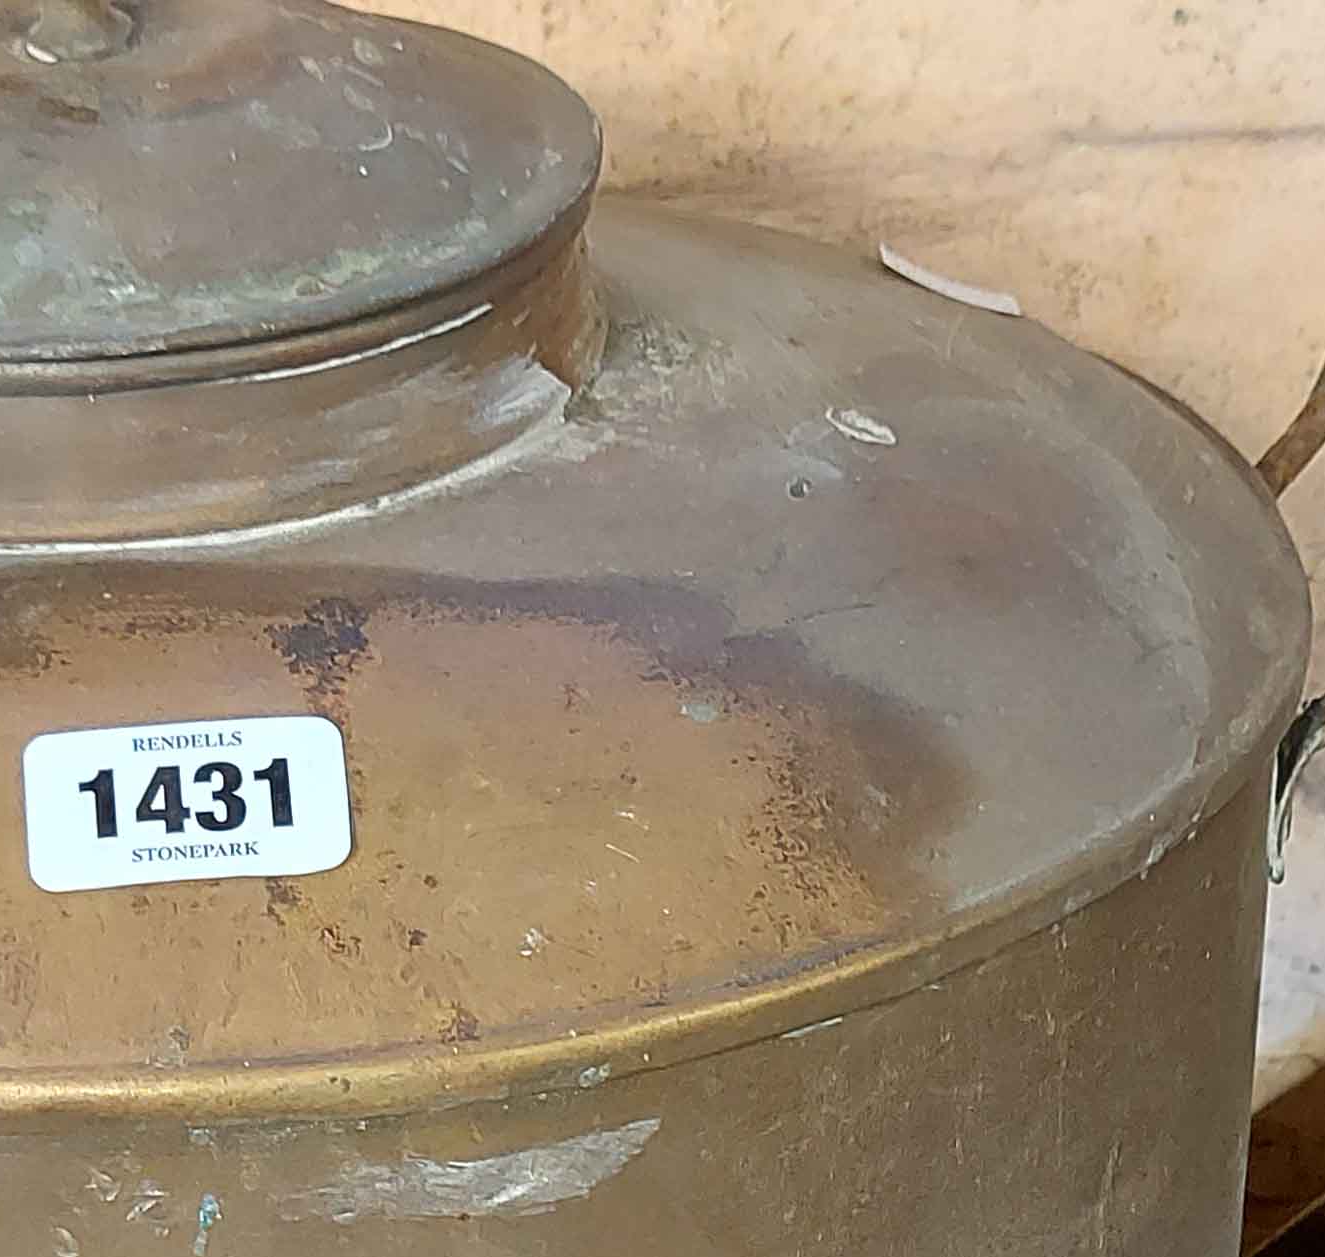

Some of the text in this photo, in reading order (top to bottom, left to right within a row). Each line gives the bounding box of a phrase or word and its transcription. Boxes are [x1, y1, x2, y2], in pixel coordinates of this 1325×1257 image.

[132, 731, 244, 752] RENDELLS
[78, 758, 294, 839] 1431
[131, 841, 260, 863] STONEPARK
